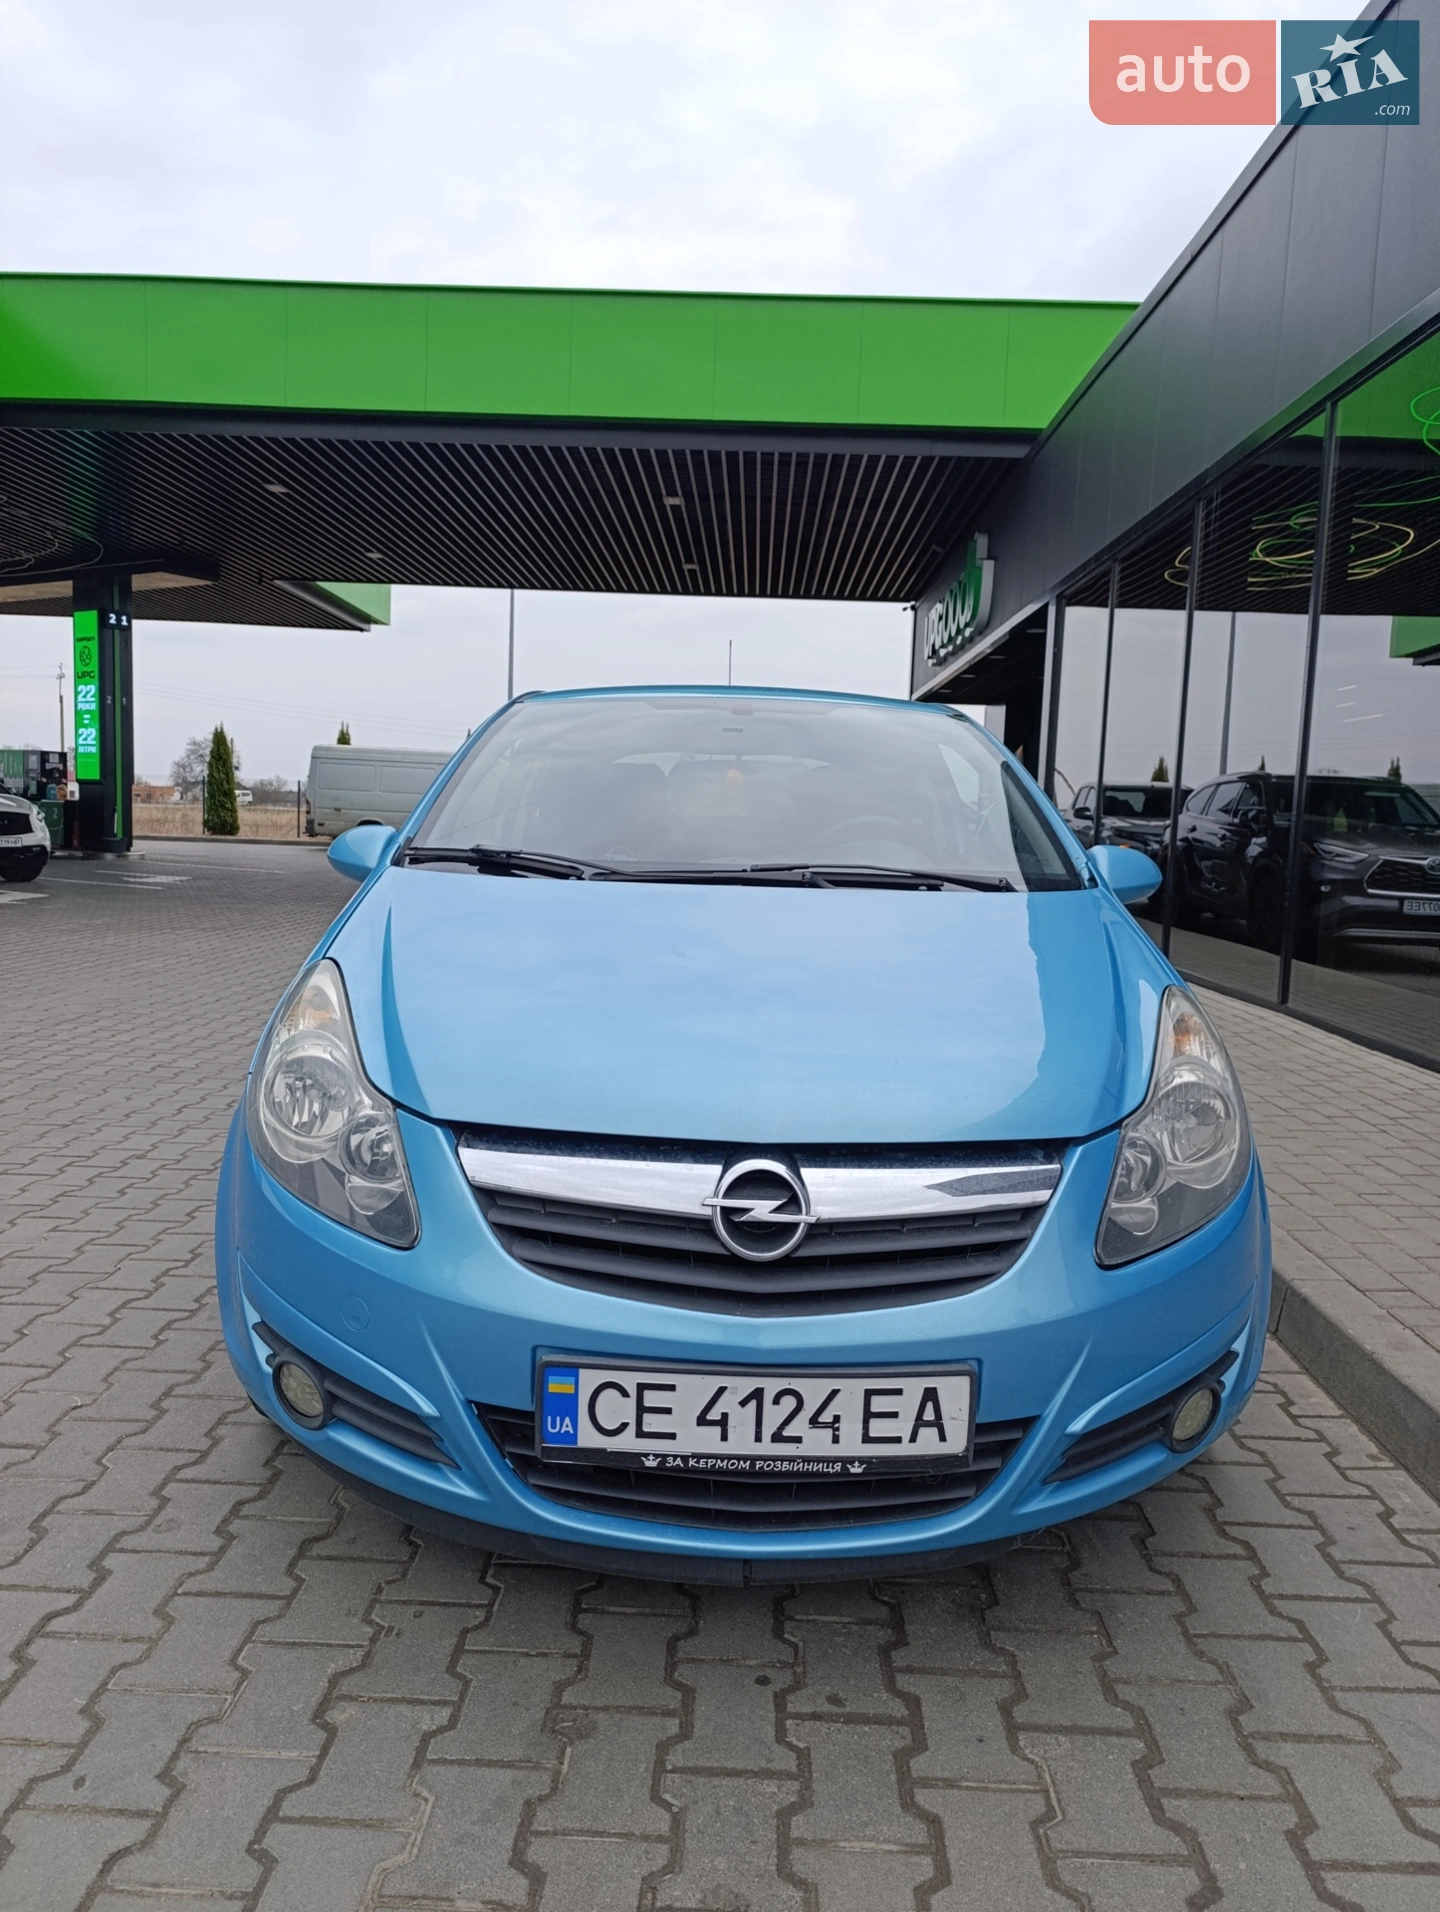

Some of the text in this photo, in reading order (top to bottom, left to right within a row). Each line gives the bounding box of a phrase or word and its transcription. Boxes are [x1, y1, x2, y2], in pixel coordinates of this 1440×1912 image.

[108, 613, 129, 626] 2 1
[77, 685, 96, 702] 22
[78, 728, 97, 745] 22
[587, 1380, 948, 1445] CE 4124 EA
[547, 1415, 574, 1435] UA
[665, 1456, 842, 1473] ЗА КЕРМОМ РОЗБІЙНИЦЯ
